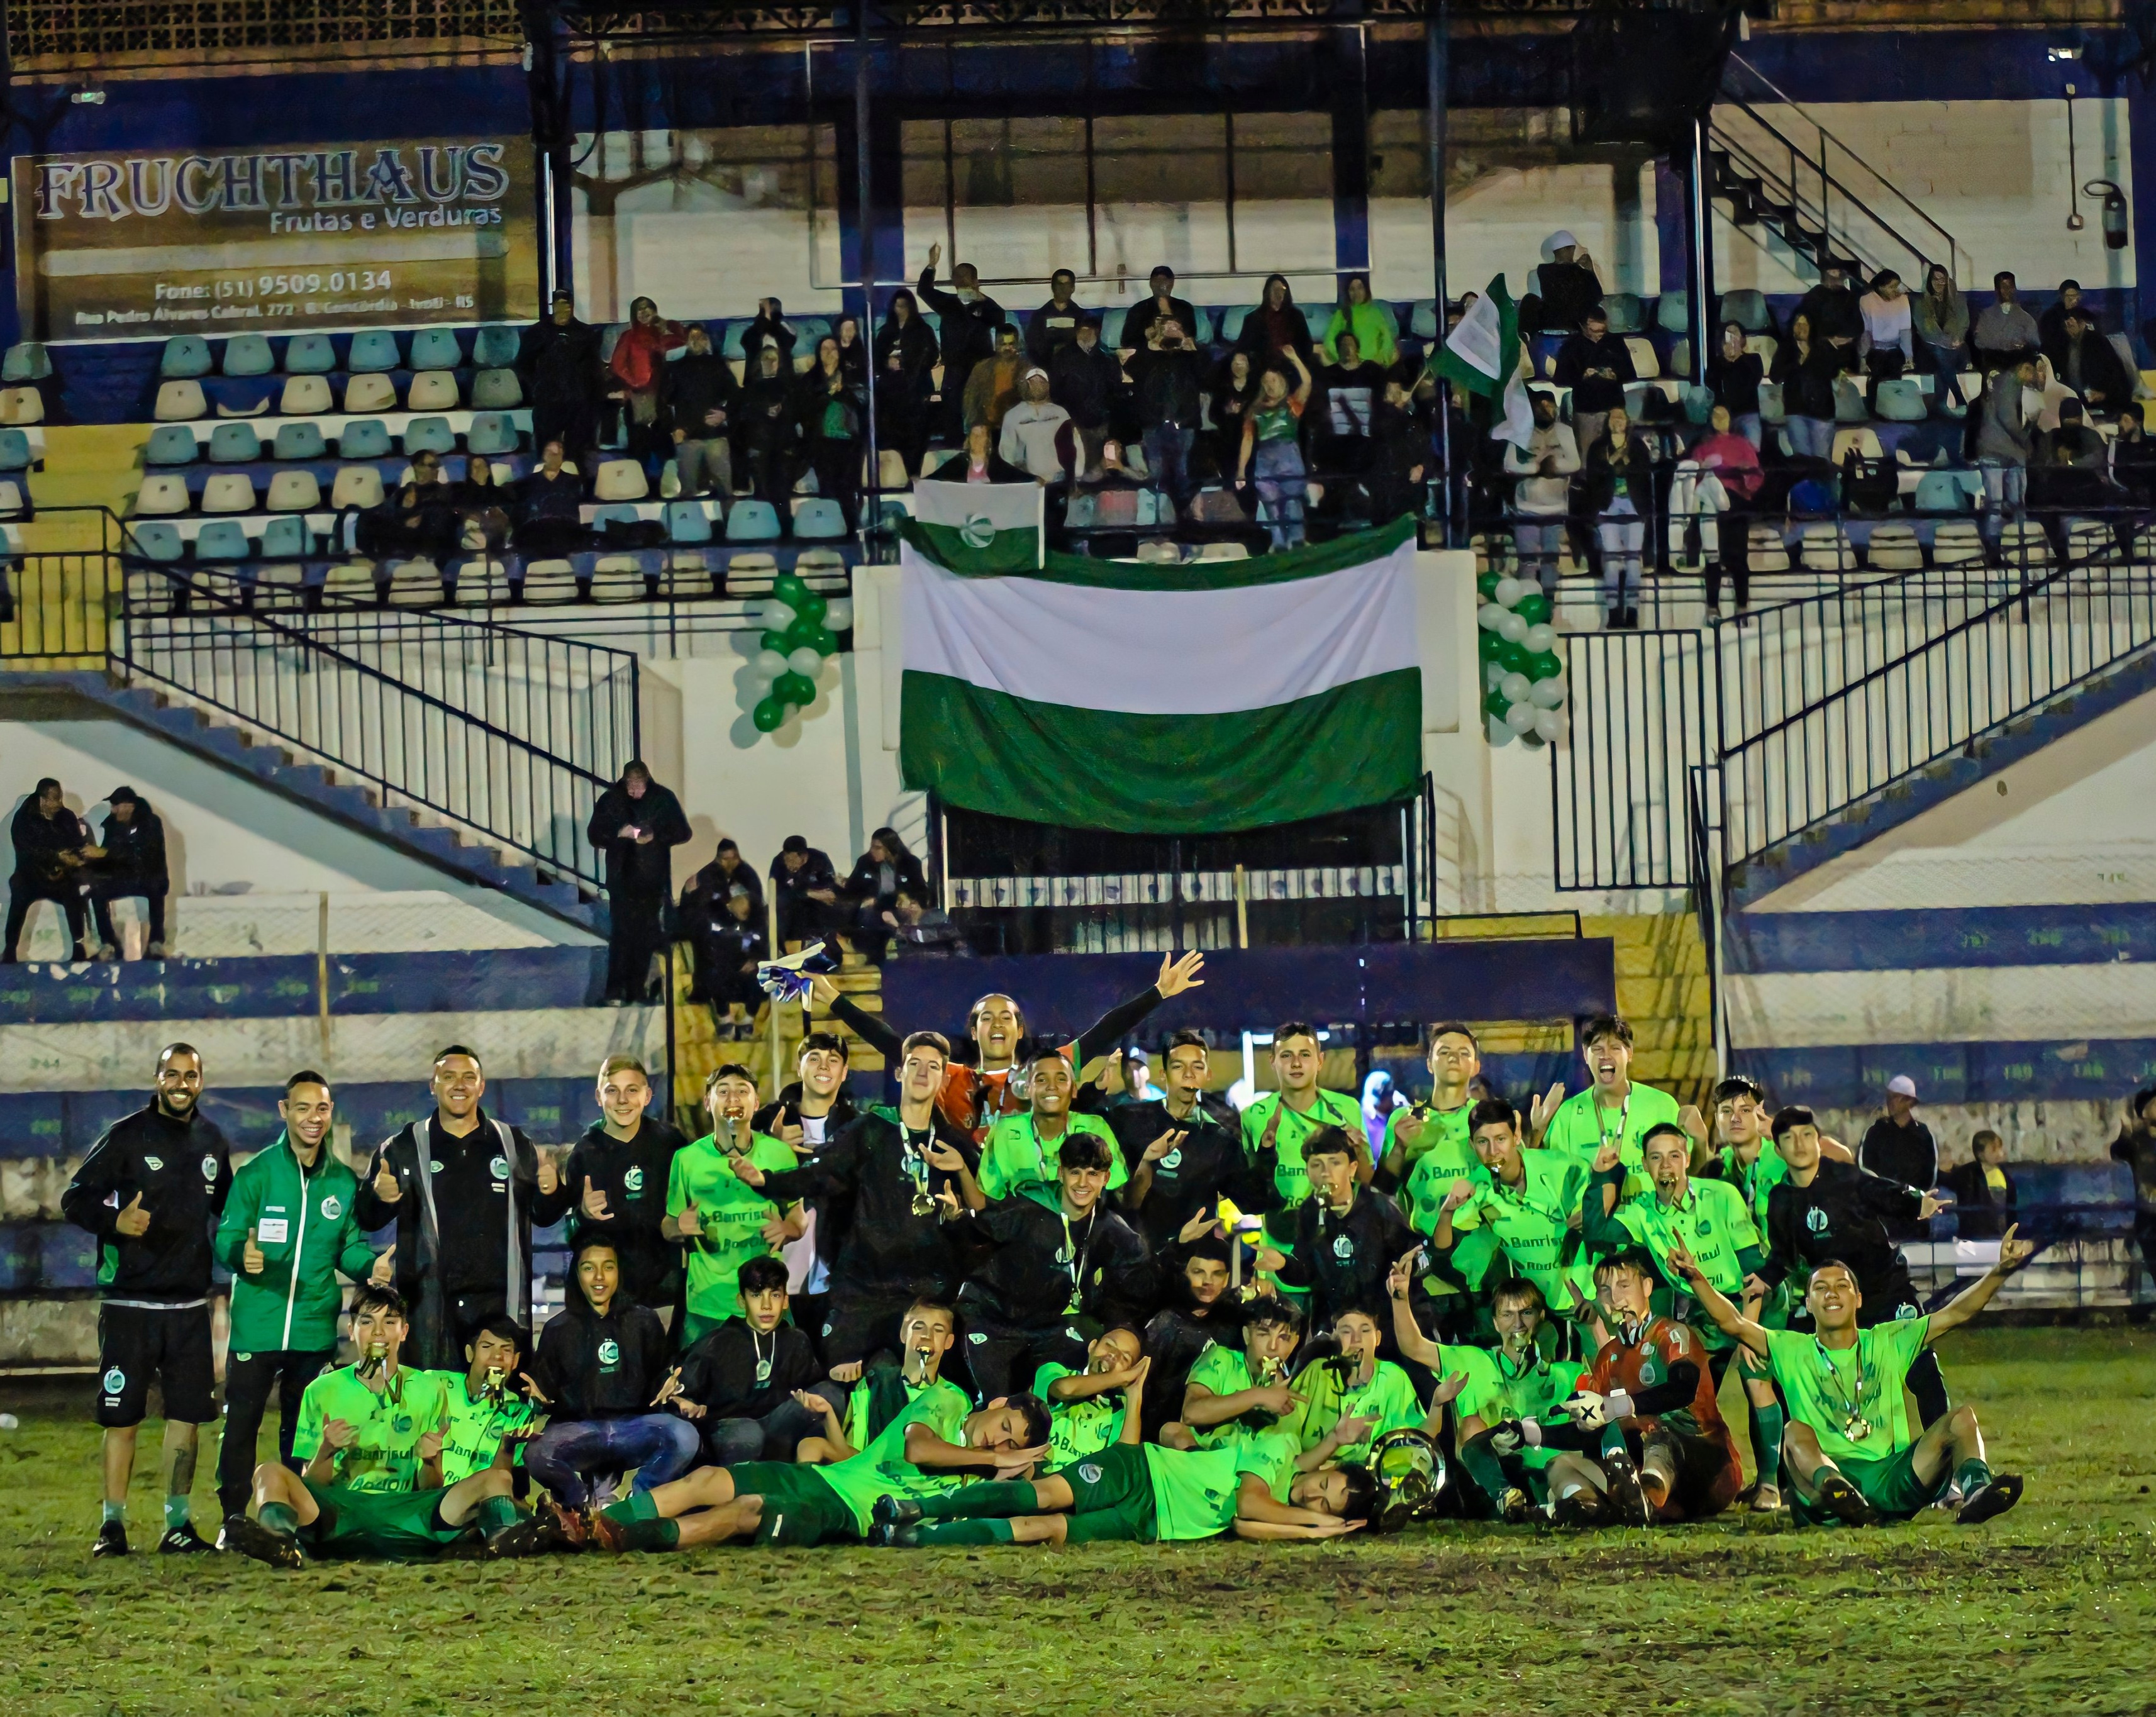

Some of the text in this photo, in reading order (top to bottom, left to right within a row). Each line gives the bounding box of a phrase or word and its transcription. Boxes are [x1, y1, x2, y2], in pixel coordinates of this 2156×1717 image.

[34, 143, 509, 221] FRUCHTHAUS
[270, 204, 503, 233] Frutas e Verduras
[155, 270, 391, 299] Fone: (51) 9509.0134
